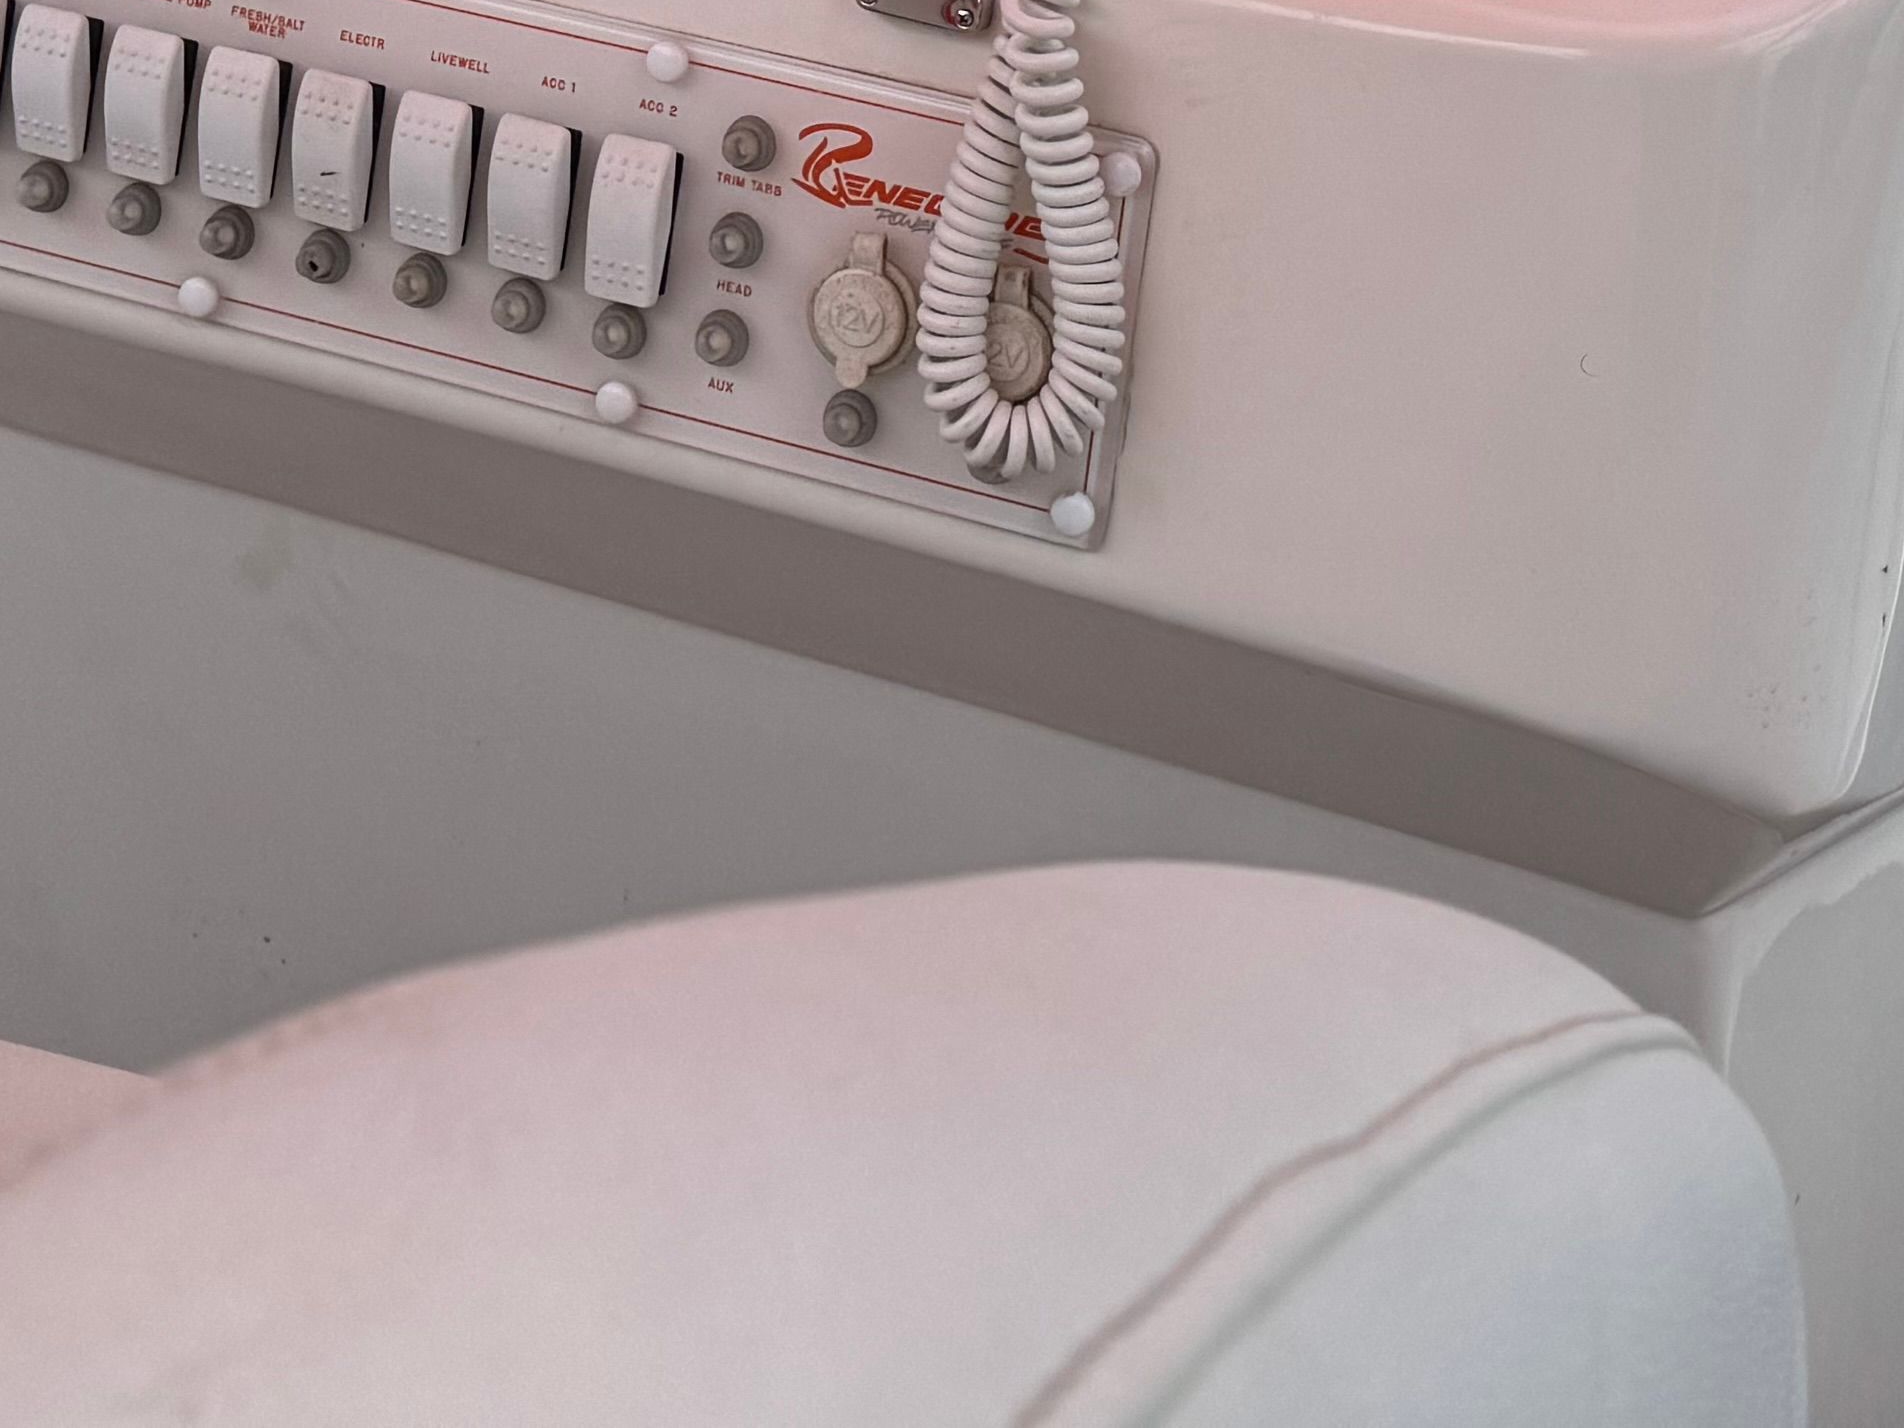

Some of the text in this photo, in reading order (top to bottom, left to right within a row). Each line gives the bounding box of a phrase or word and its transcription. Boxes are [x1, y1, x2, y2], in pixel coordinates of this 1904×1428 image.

[248, 20, 286, 39] WATER
[339, 29, 385, 50] ELECTR
[430, 50, 490, 74] LIVEWELL
[541, 75, 566, 92] ACC
[639, 97, 678, 117] ACC 2
[716, 171, 782, 197] TRIM TABS
[716, 278, 753, 297] HEAD
[835, 304, 880, 334] 12V
[987, 341, 1025, 369] 2V
[707, 376, 734, 393] AUX
